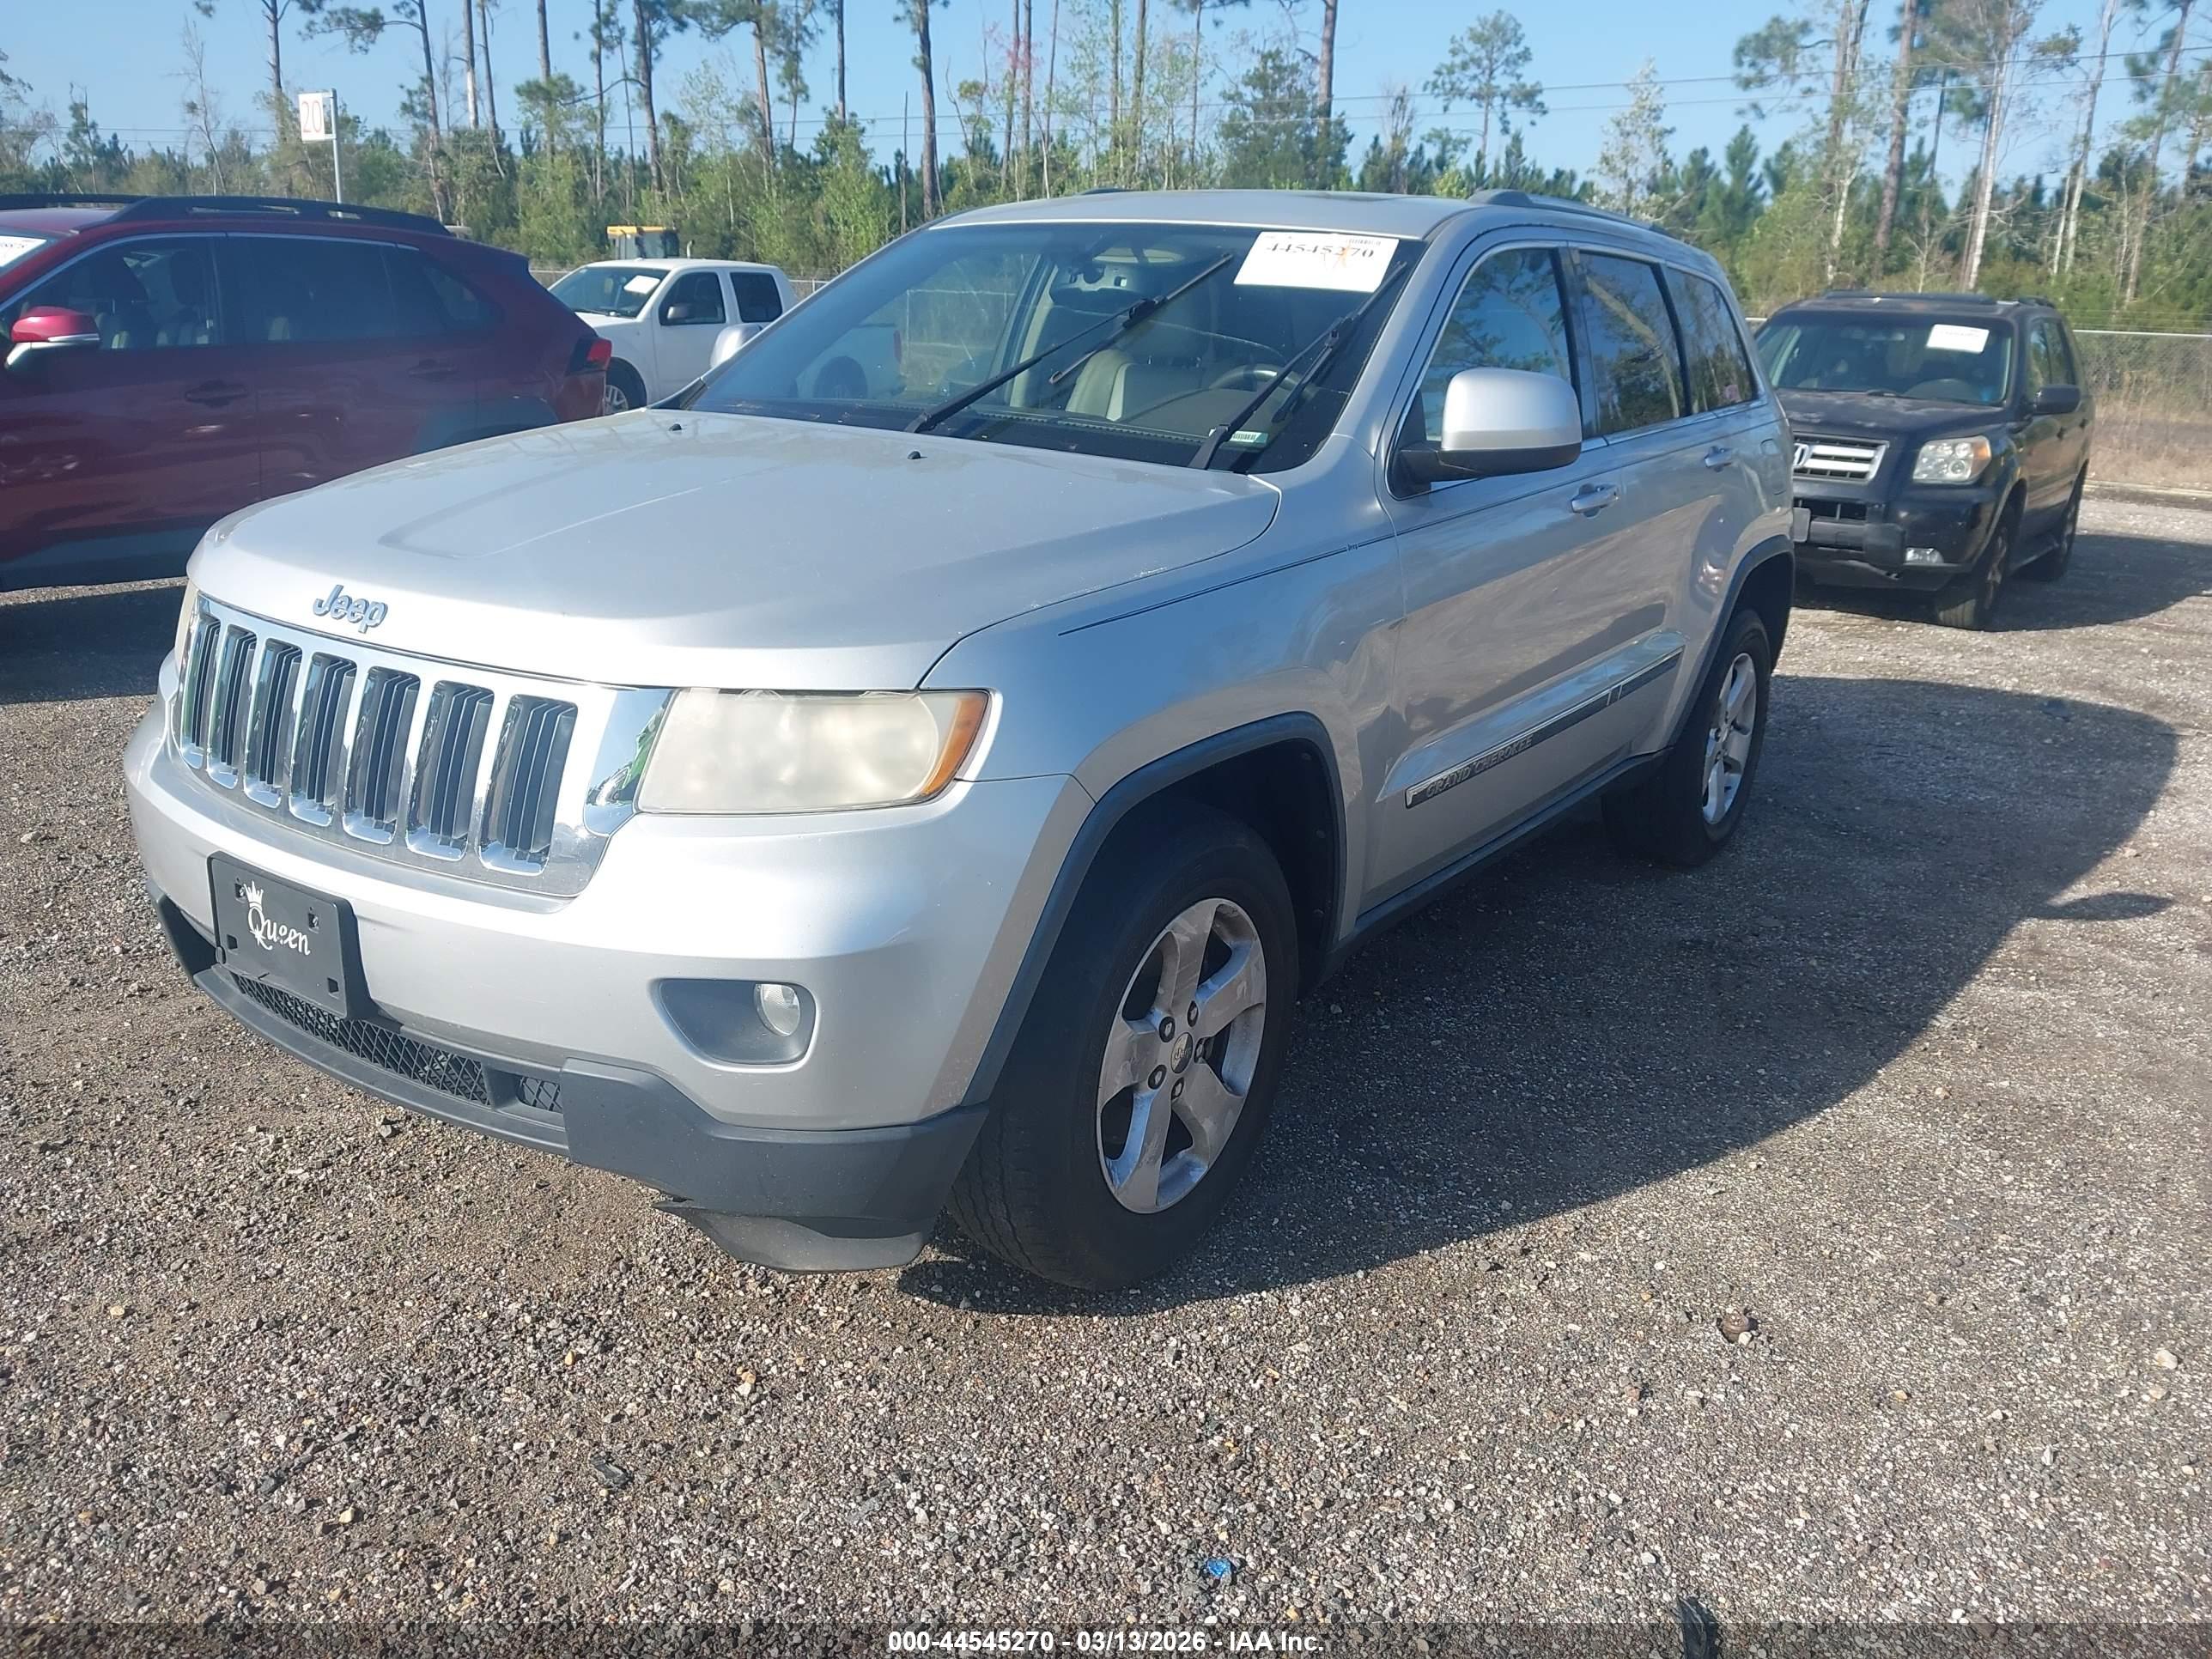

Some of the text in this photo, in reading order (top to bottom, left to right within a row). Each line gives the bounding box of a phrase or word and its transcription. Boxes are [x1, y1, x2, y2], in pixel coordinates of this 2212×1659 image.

[301, 100, 322, 133] 20
[1266, 242, 1375, 258] 44545270
[313, 584, 388, 634] Jeep
[1426, 734, 1534, 798] GRAND CHEROKEE
[247, 906, 311, 956] Queen
